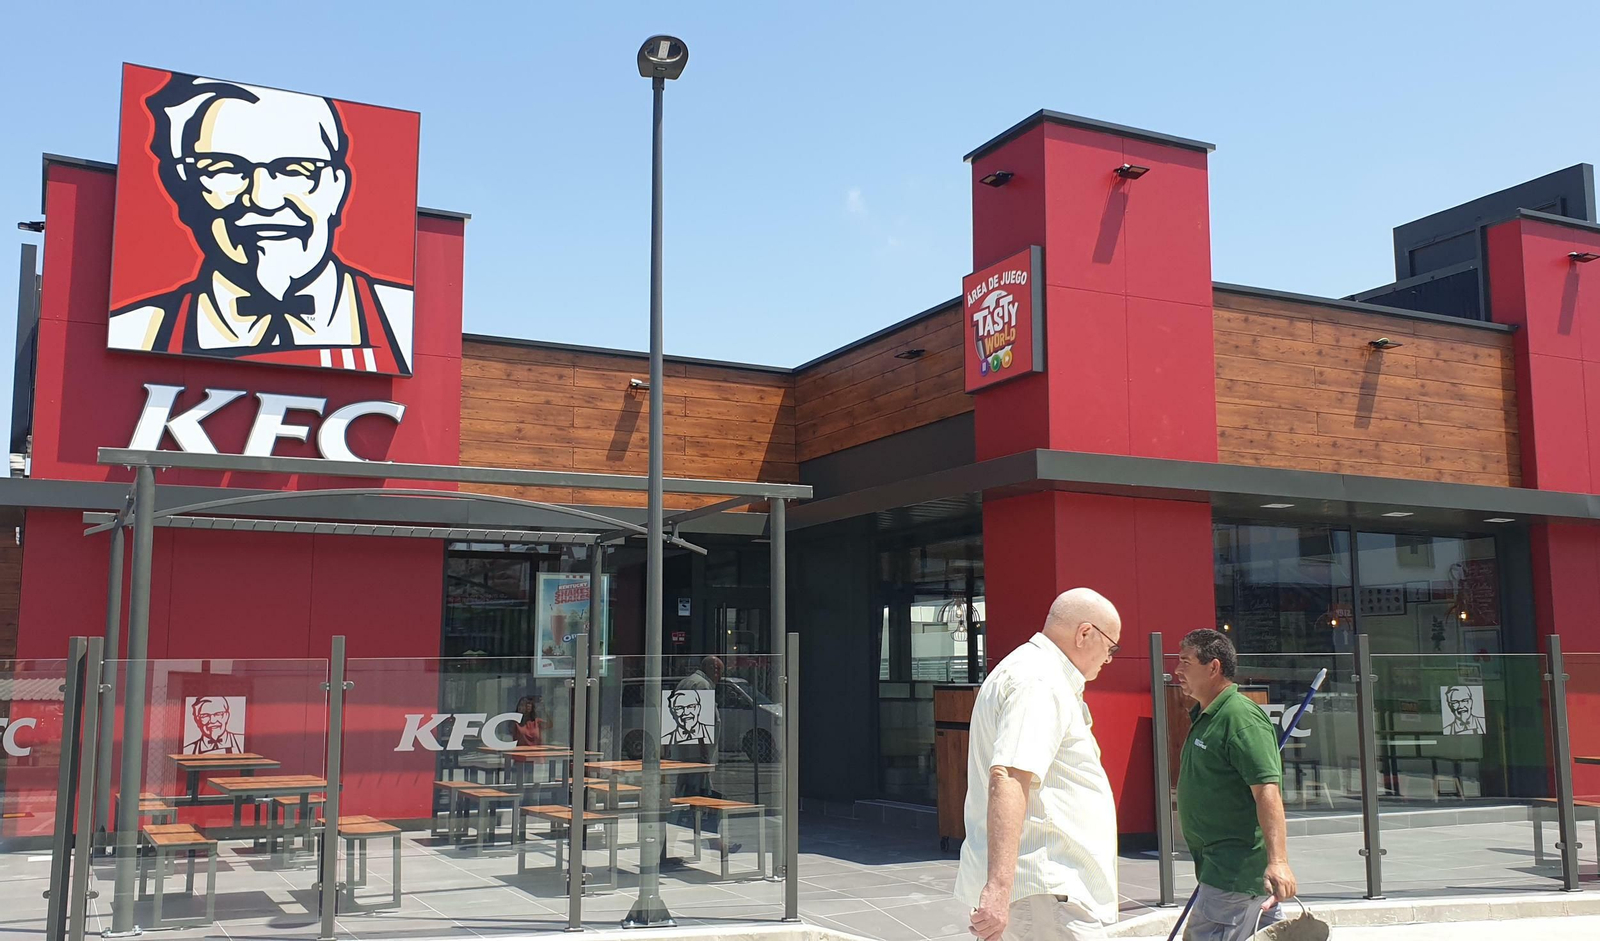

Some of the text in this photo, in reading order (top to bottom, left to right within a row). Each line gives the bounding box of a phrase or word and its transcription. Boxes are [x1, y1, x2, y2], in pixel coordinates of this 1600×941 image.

[967, 270, 1028, 307] ÁREA DE JUEGO
[973, 294, 1019, 336] TASTY
[985, 323, 1016, 355] WORLD
[127, 383, 407, 463] KFC
[393, 712, 523, 752] KFC
